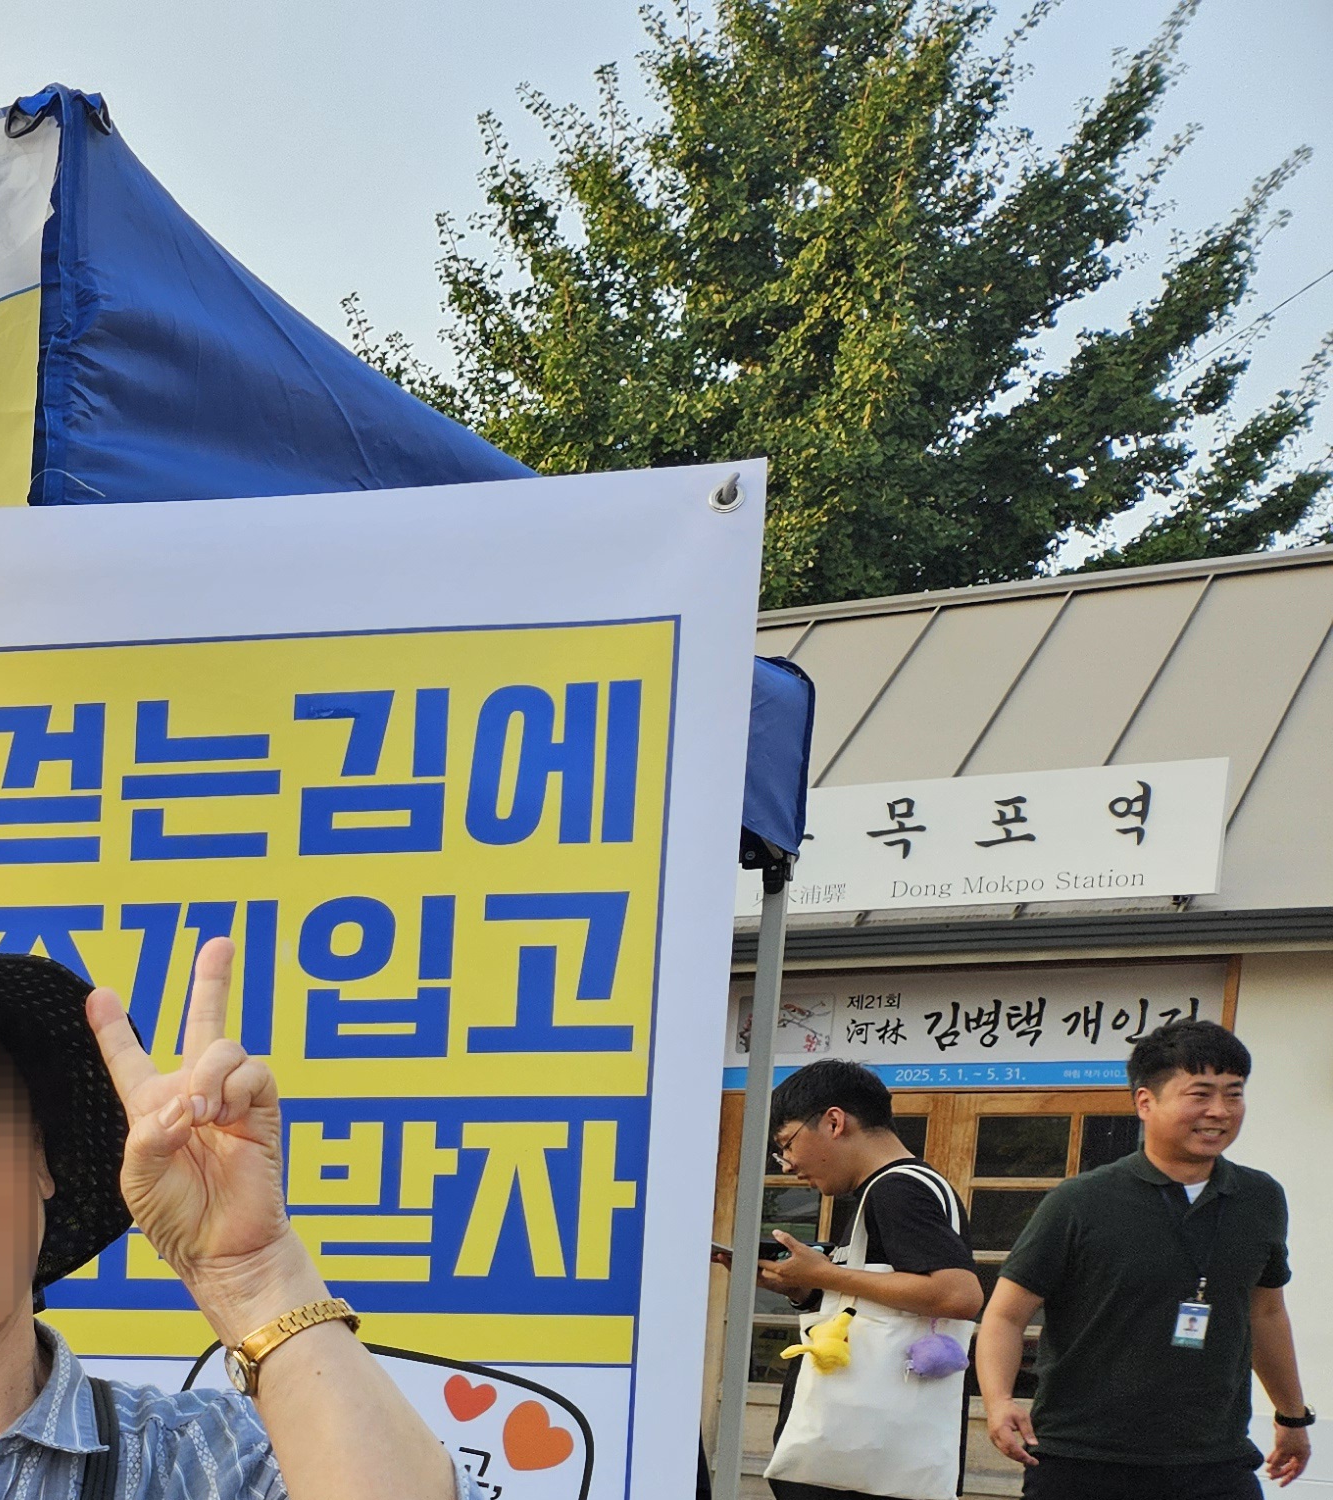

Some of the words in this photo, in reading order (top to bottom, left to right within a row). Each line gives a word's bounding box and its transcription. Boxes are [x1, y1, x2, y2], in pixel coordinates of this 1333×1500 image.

[803, 779, 1153, 860] 목포역
[890, 879, 953, 899] Dong
[961, 874, 1045, 896] Mokpo
[1055, 868, 1145, 890] Station
[846, 992, 902, 1010] 제21회
[846, 1017, 908, 1045] 河林
[923, 996, 1047, 1052] 김병택
[895, 1068, 934, 1082] 2025.
